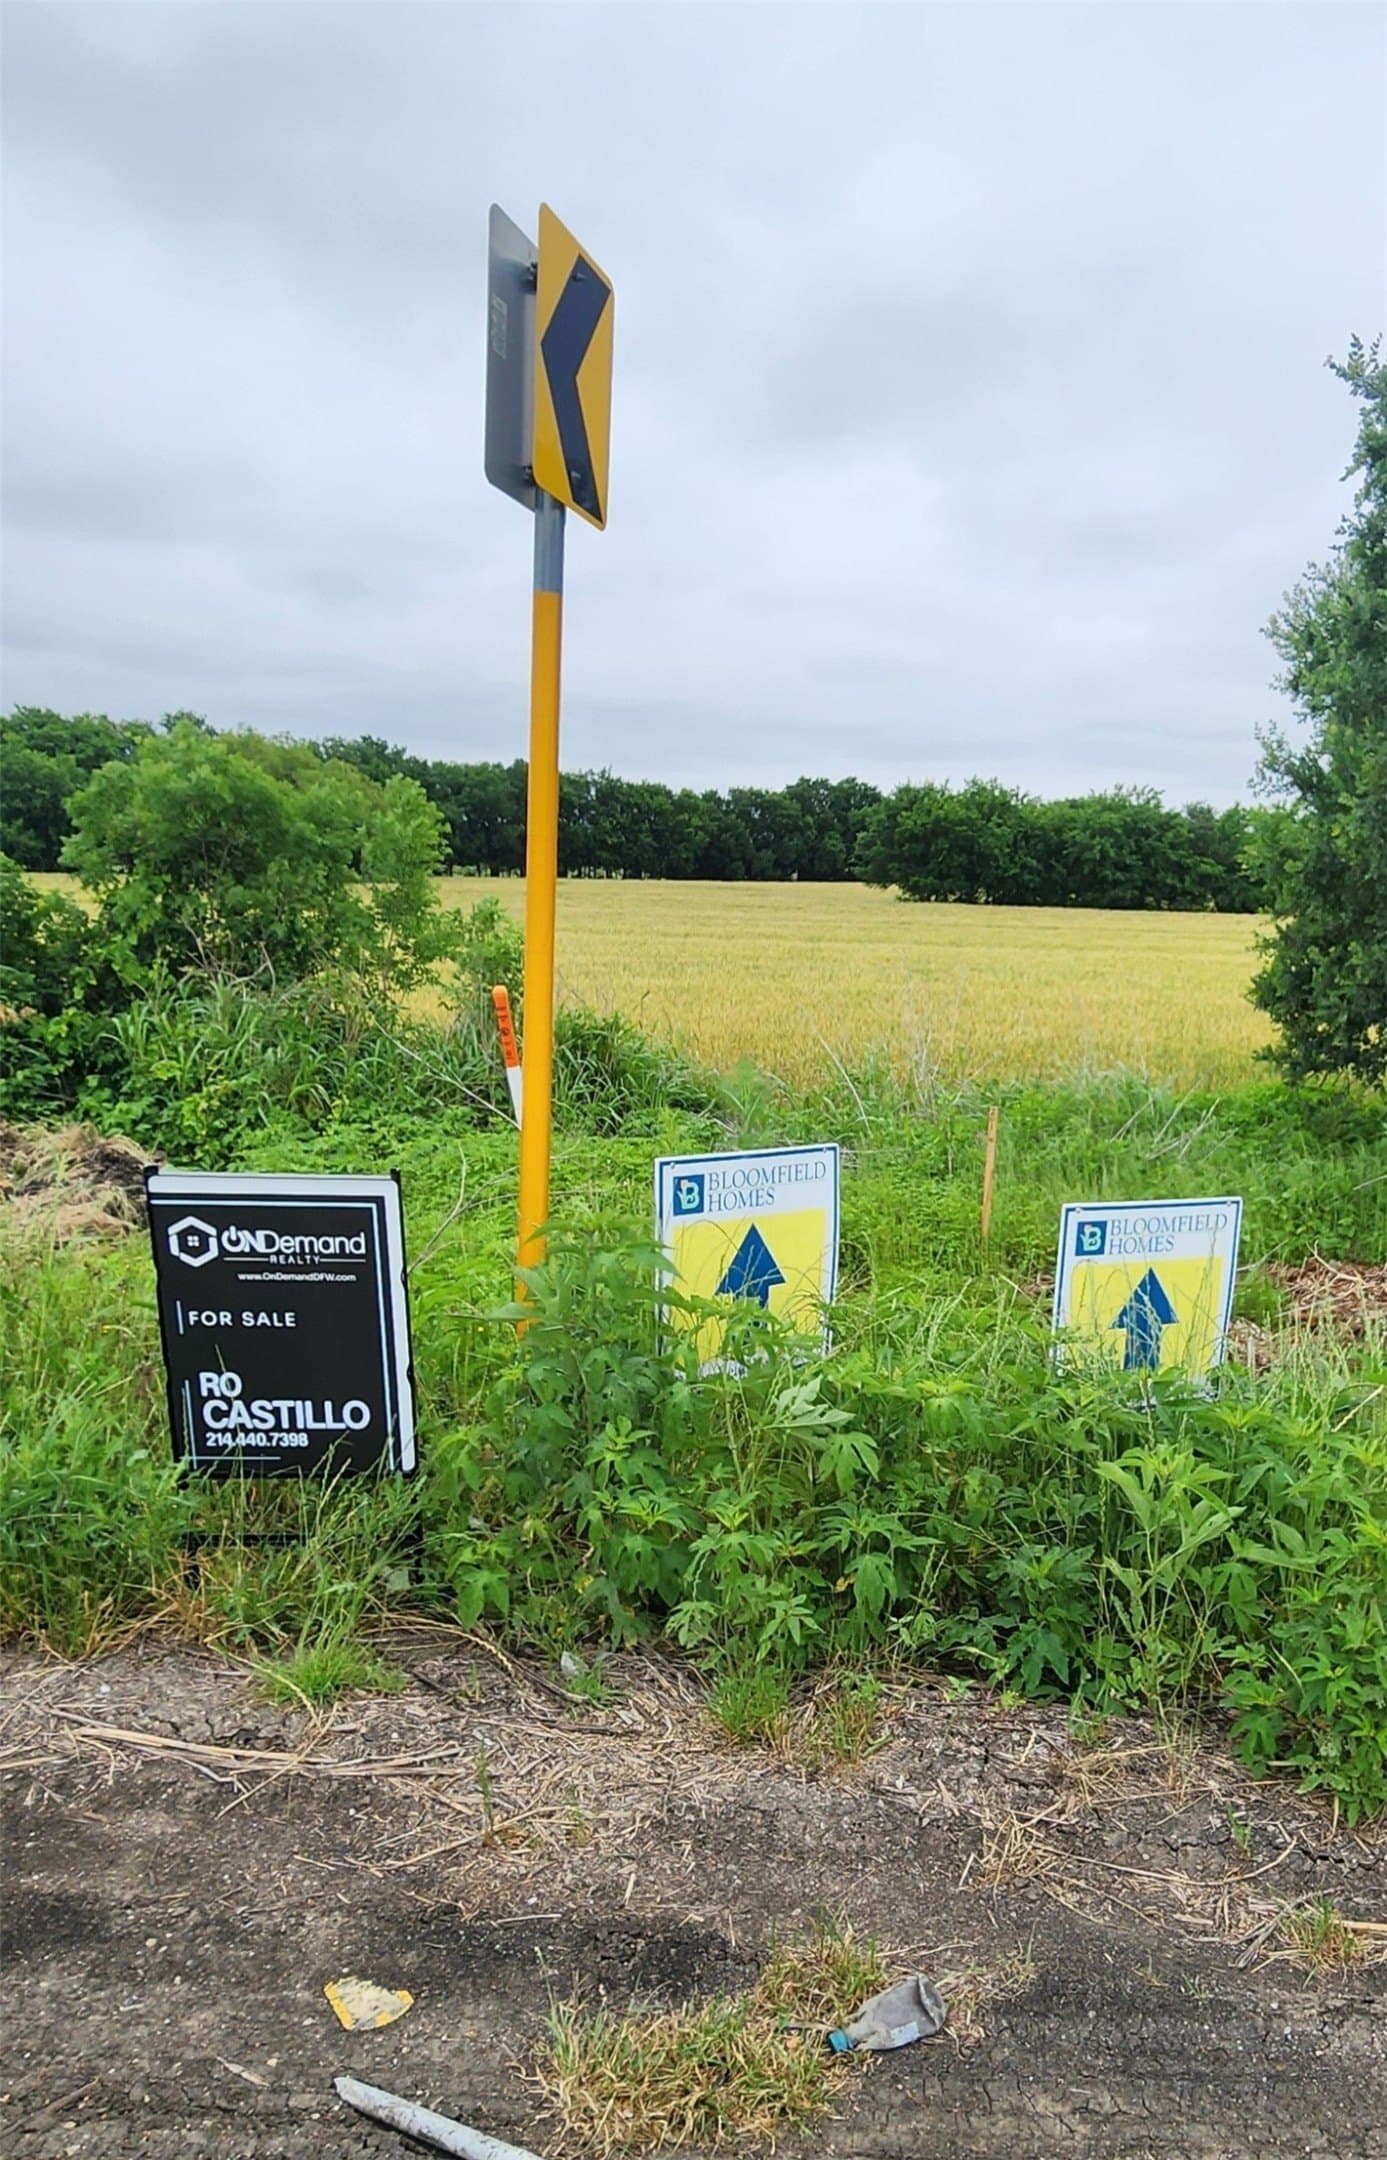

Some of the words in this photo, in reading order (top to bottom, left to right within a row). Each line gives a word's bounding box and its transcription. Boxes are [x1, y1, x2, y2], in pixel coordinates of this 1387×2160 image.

[708, 1161, 826, 1190] BLOOMFIELD
[709, 1187, 776, 1212] HOMES
[1110, 1213, 1228, 1236] BLOOMFIELD
[221, 1225, 366, 1255] ONDemand
[1109, 1235, 1175, 1256] HOMES
[269, 1255, 321, 1265] REALTY
[238, 1272, 357, 1282] www.OnDemandDFW.com
[189, 1310, 233, 1327] FOR
[242, 1311, 297, 1328] SALE
[199, 1372, 242, 1398] RO
[203, 1400, 371, 1430] CASTILLO
[206, 1432, 310, 1448] 214.440.7398
